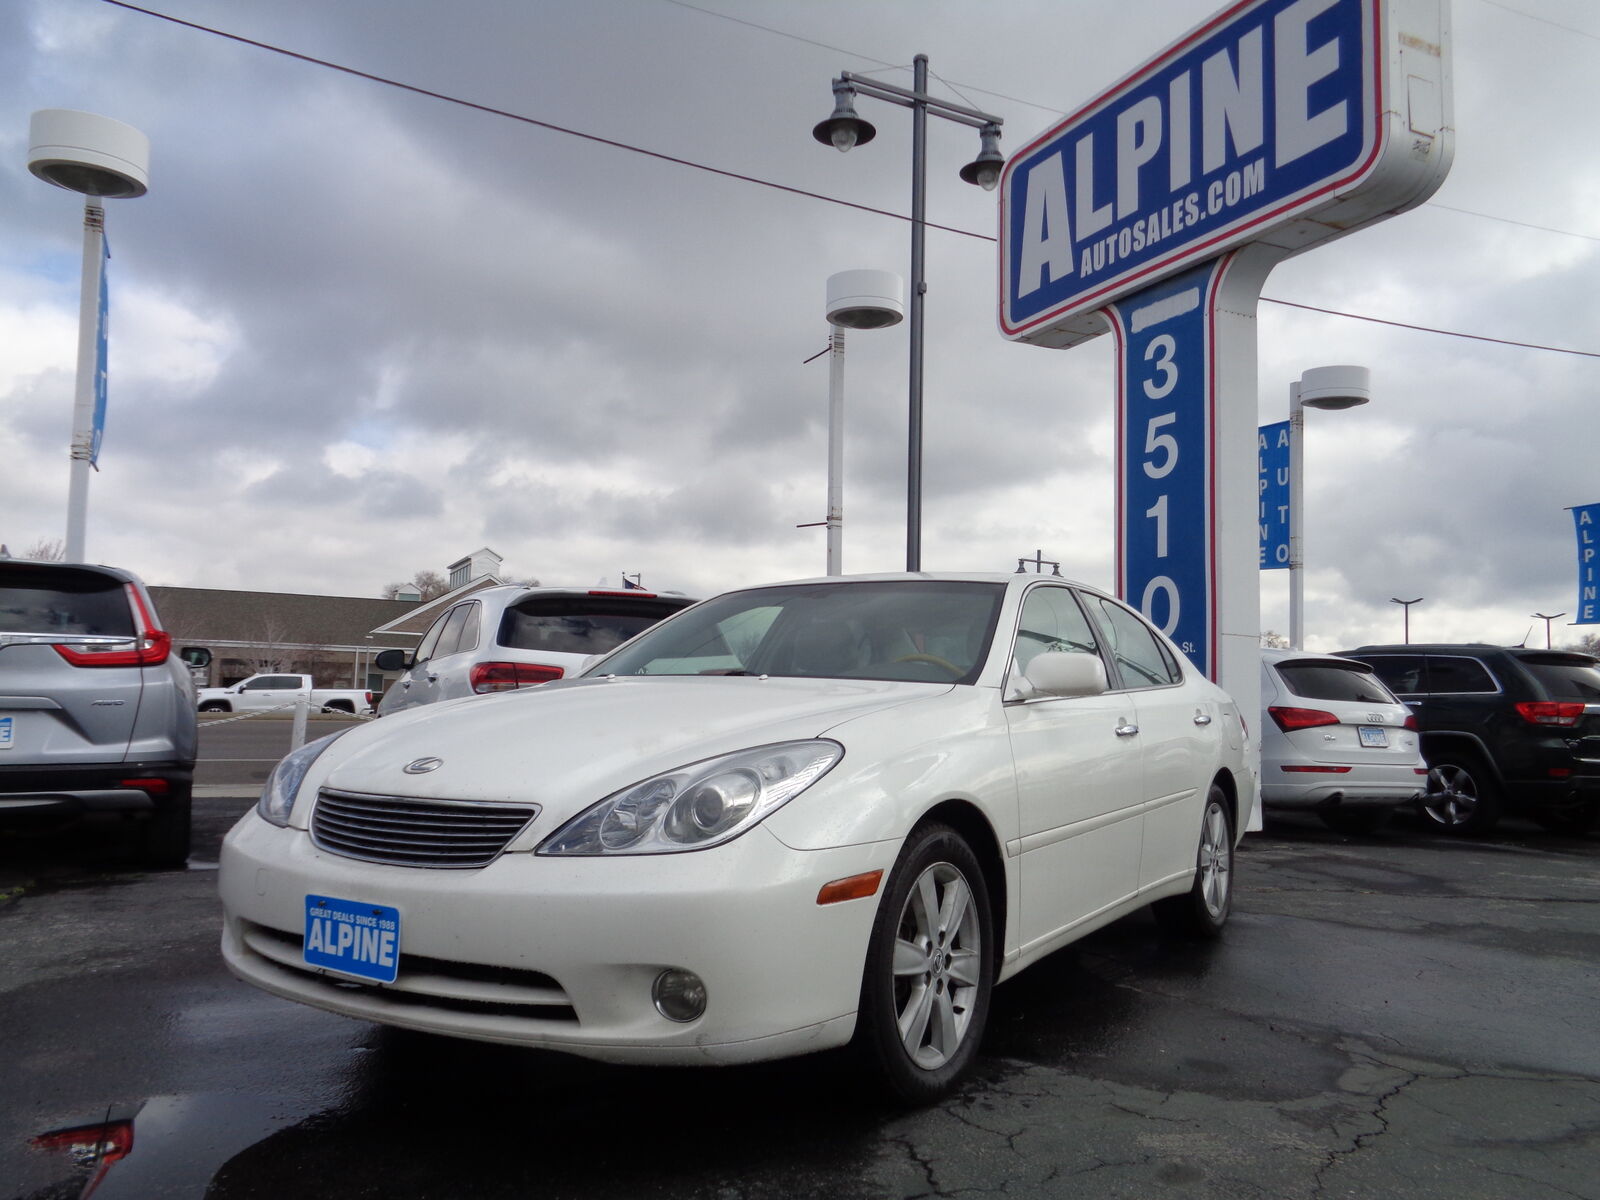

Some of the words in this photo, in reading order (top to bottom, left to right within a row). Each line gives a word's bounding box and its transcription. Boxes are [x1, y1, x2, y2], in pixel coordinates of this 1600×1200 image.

[1018, 0, 1348, 299] ALPINE
[1080, 158, 1265, 278] AUTOSALES.COM
[1142, 334, 1180, 639] 3510
[1276, 429, 1289, 563] AUTO
[1580, 511, 1596, 619] ALPINE
[1182, 641, 1196, 653] St.
[307, 918, 395, 968] ALPINE
[309, 907, 331, 918] GREAT
[333, 911, 355, 923] DEALS
[356, 915, 377, 927] SINCE
[379, 919, 395, 930] 1988
